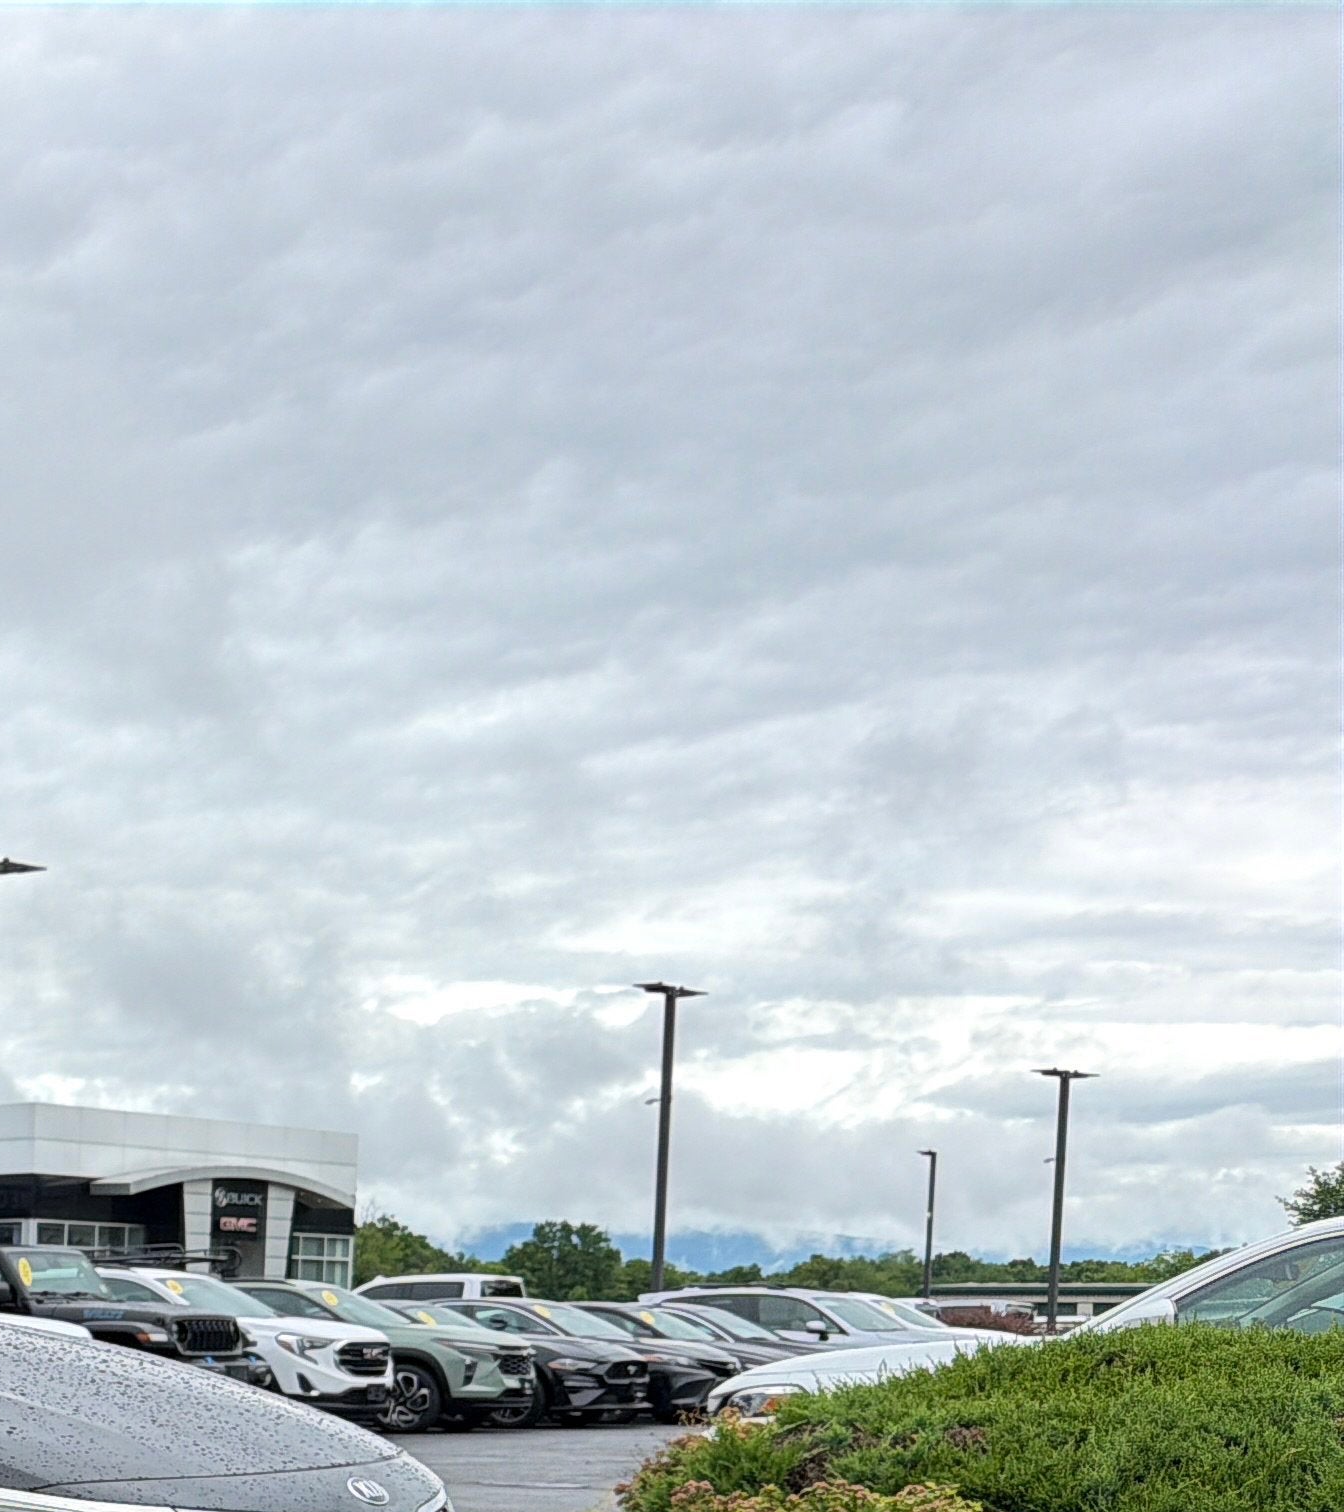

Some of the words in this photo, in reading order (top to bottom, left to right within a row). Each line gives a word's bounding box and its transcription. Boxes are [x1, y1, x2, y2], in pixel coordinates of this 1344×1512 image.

[226, 1192, 263, 1206] BUICK
[219, 1216, 257, 1233] GMC
[349, 1478, 385, 1501] KIA
